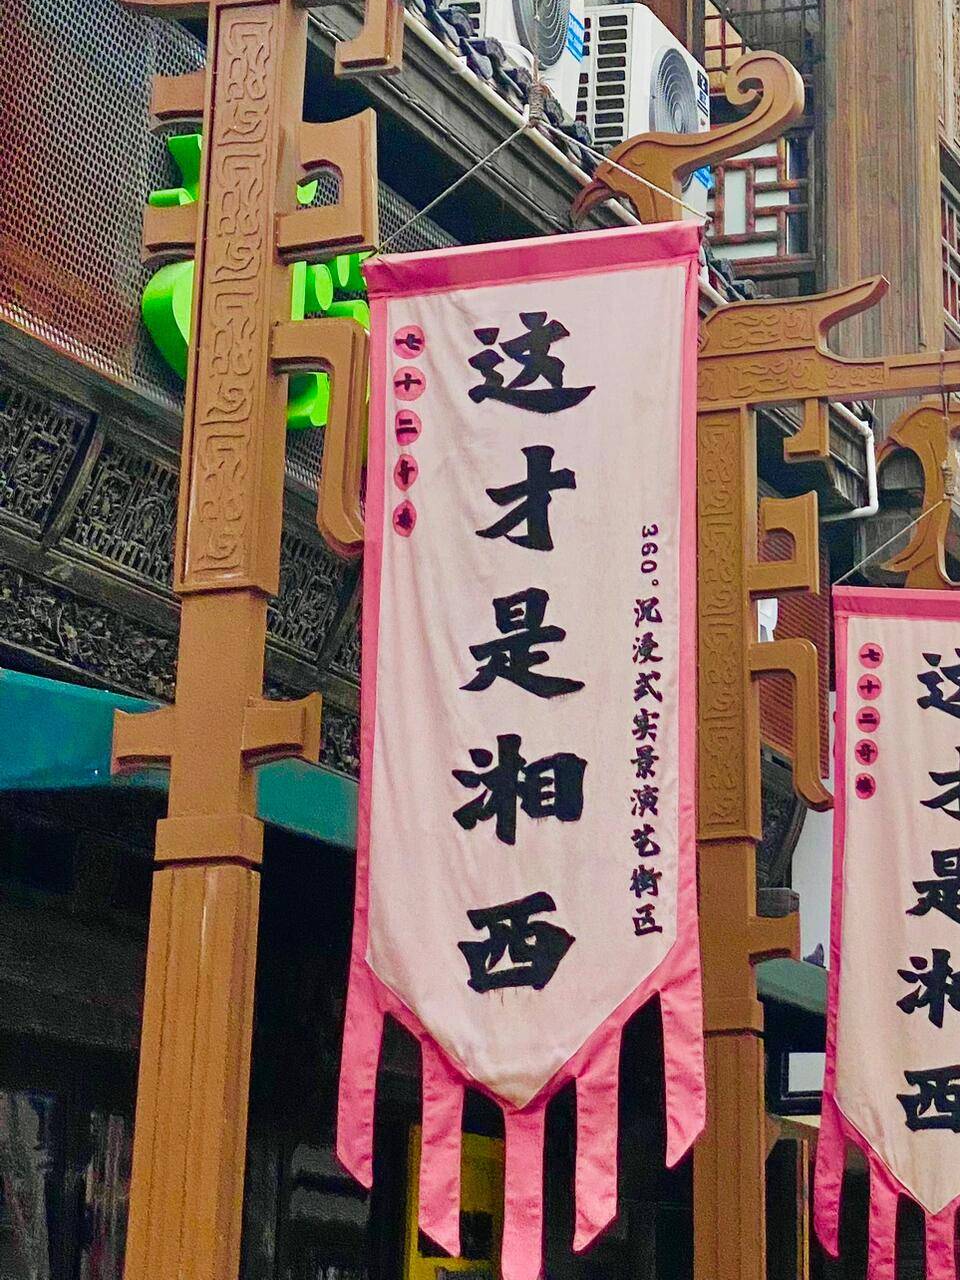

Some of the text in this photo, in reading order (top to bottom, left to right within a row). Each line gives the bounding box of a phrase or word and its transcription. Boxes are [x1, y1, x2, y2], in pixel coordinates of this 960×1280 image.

[452, 311, 596, 994] 这才是湘西
[630, 524, 664, 937] 360°沉浸式实景演艺街区
